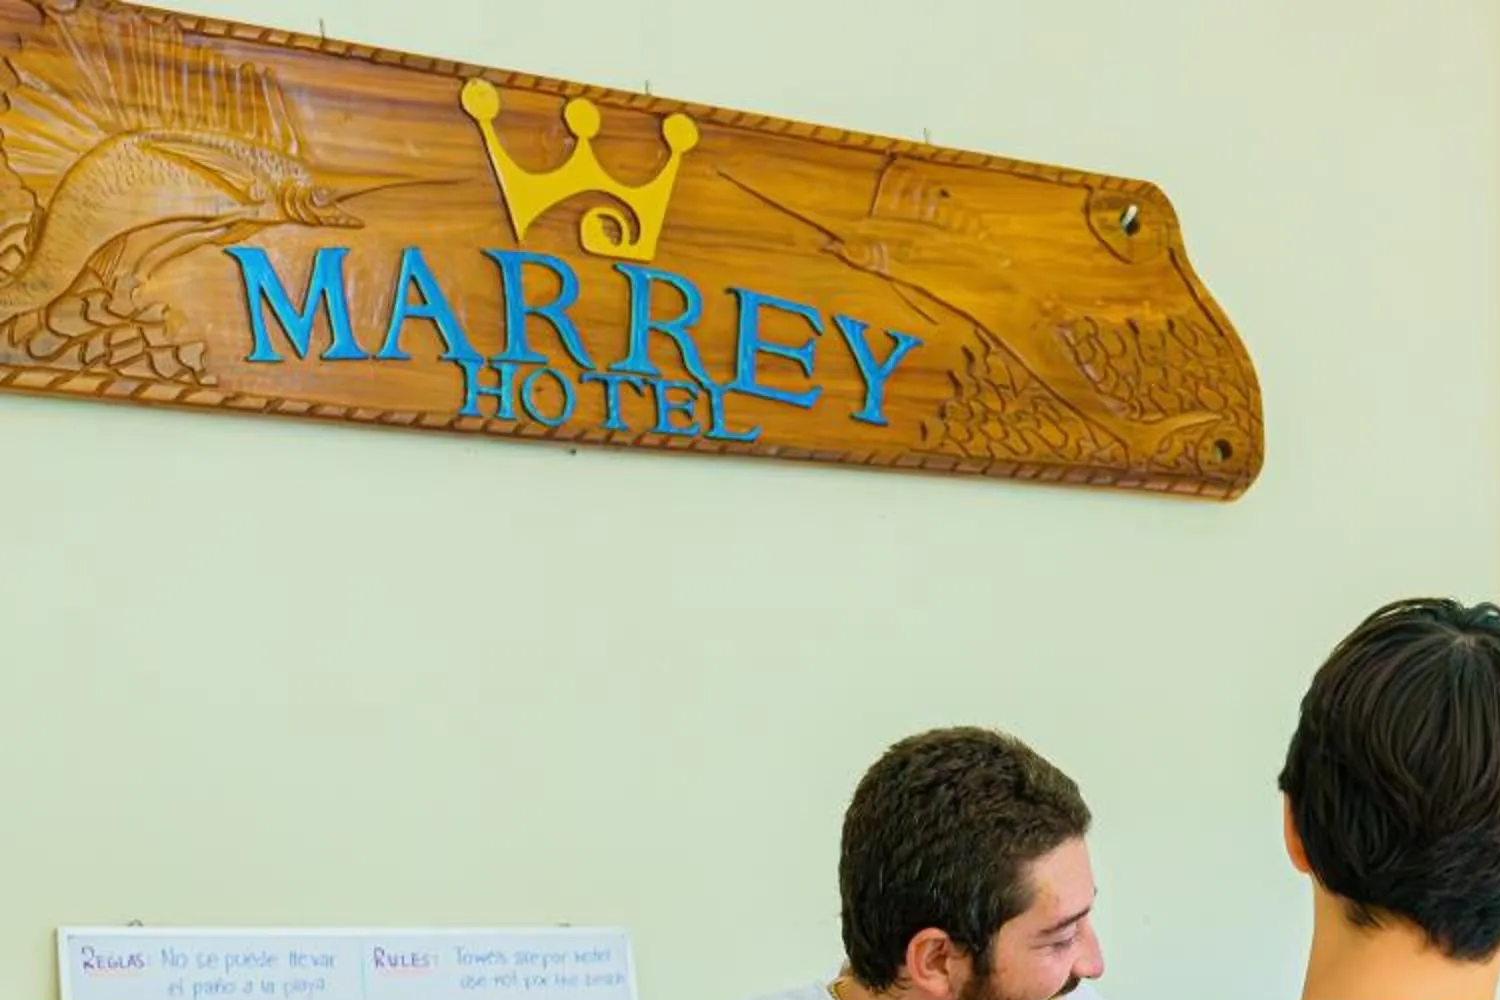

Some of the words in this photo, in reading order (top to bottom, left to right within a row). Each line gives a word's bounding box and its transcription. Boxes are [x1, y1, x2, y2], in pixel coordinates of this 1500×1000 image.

[223, 246, 923, 426] MARREY
[454, 359, 762, 443] HOTEL
[160, 947, 189, 970] No
[196, 950, 219, 970] se
[225, 948, 279, 974] puede
[289, 947, 336, 969] llevar
[167, 977, 184, 997] el
[243, 979, 253, 995] a
[260, 978, 276, 995] la
[494, 973, 517, 988] not
